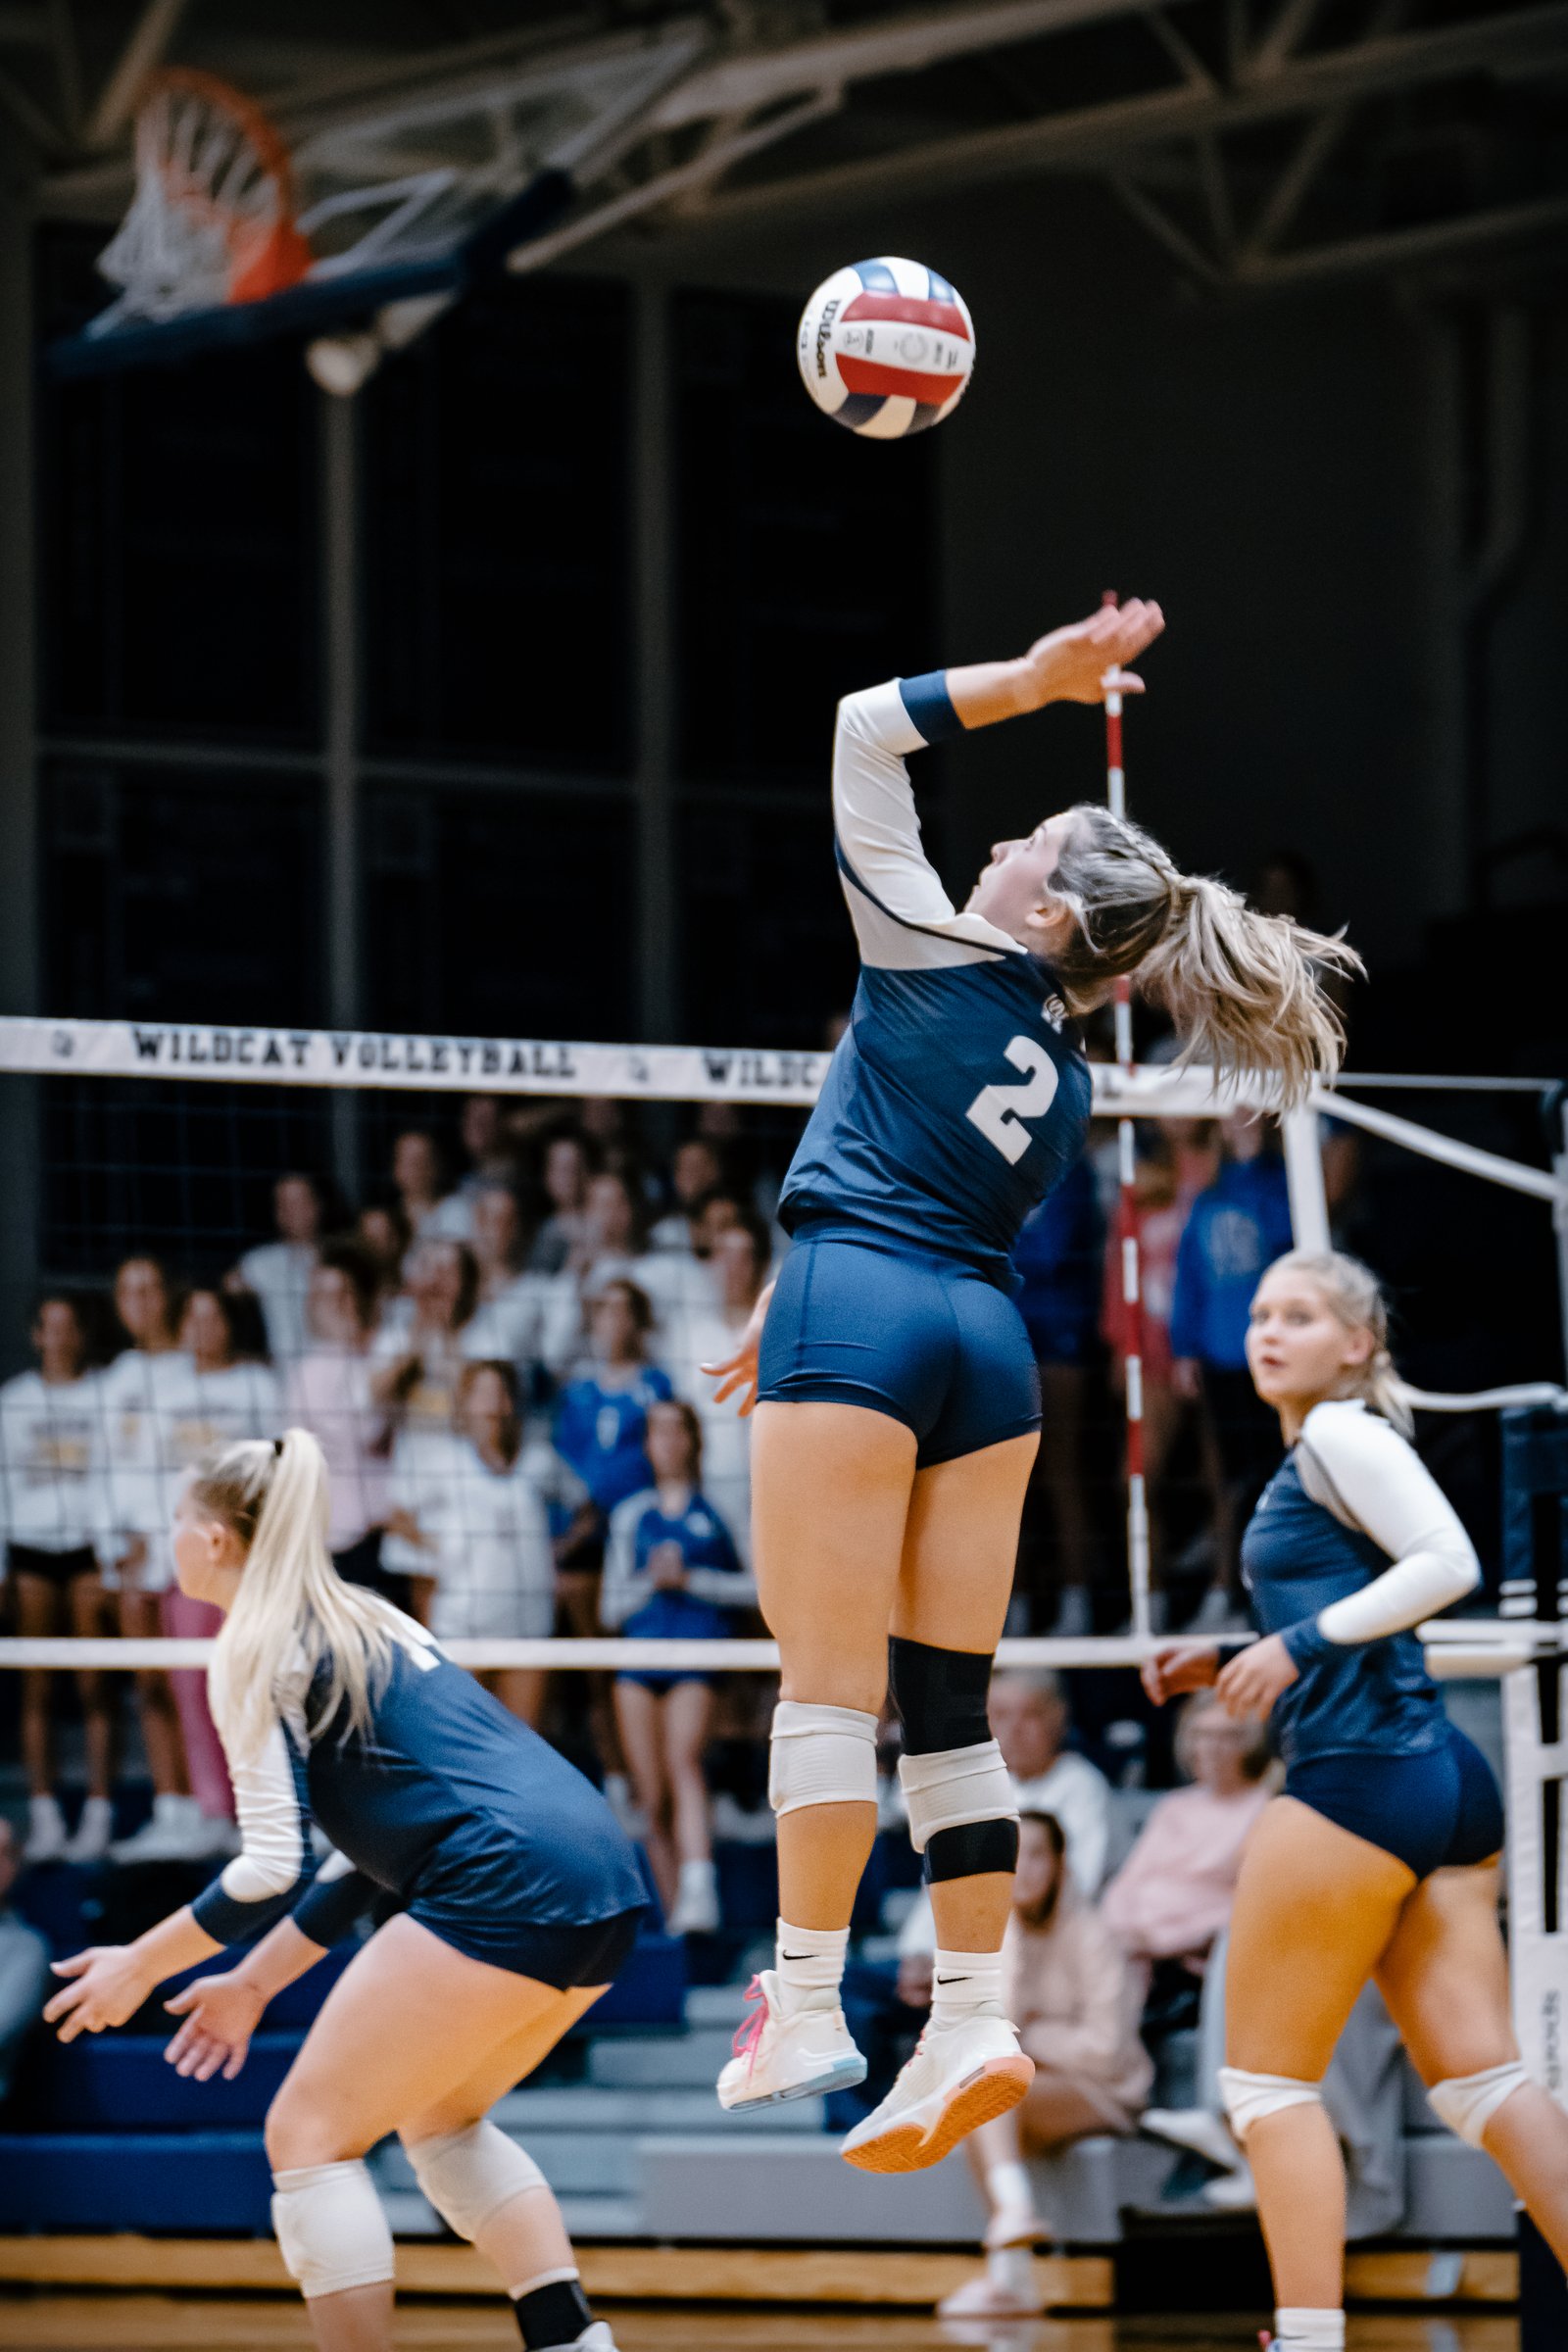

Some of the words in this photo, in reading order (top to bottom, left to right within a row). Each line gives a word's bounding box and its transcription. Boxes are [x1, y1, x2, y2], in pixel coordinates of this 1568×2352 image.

[134, 1029, 310, 1066] WILDCAT
[331, 1037, 575, 1076] VOLLEYBALL
[704, 1056, 819, 1087] WILDC
[965, 1035, 1059, 1165] 2
